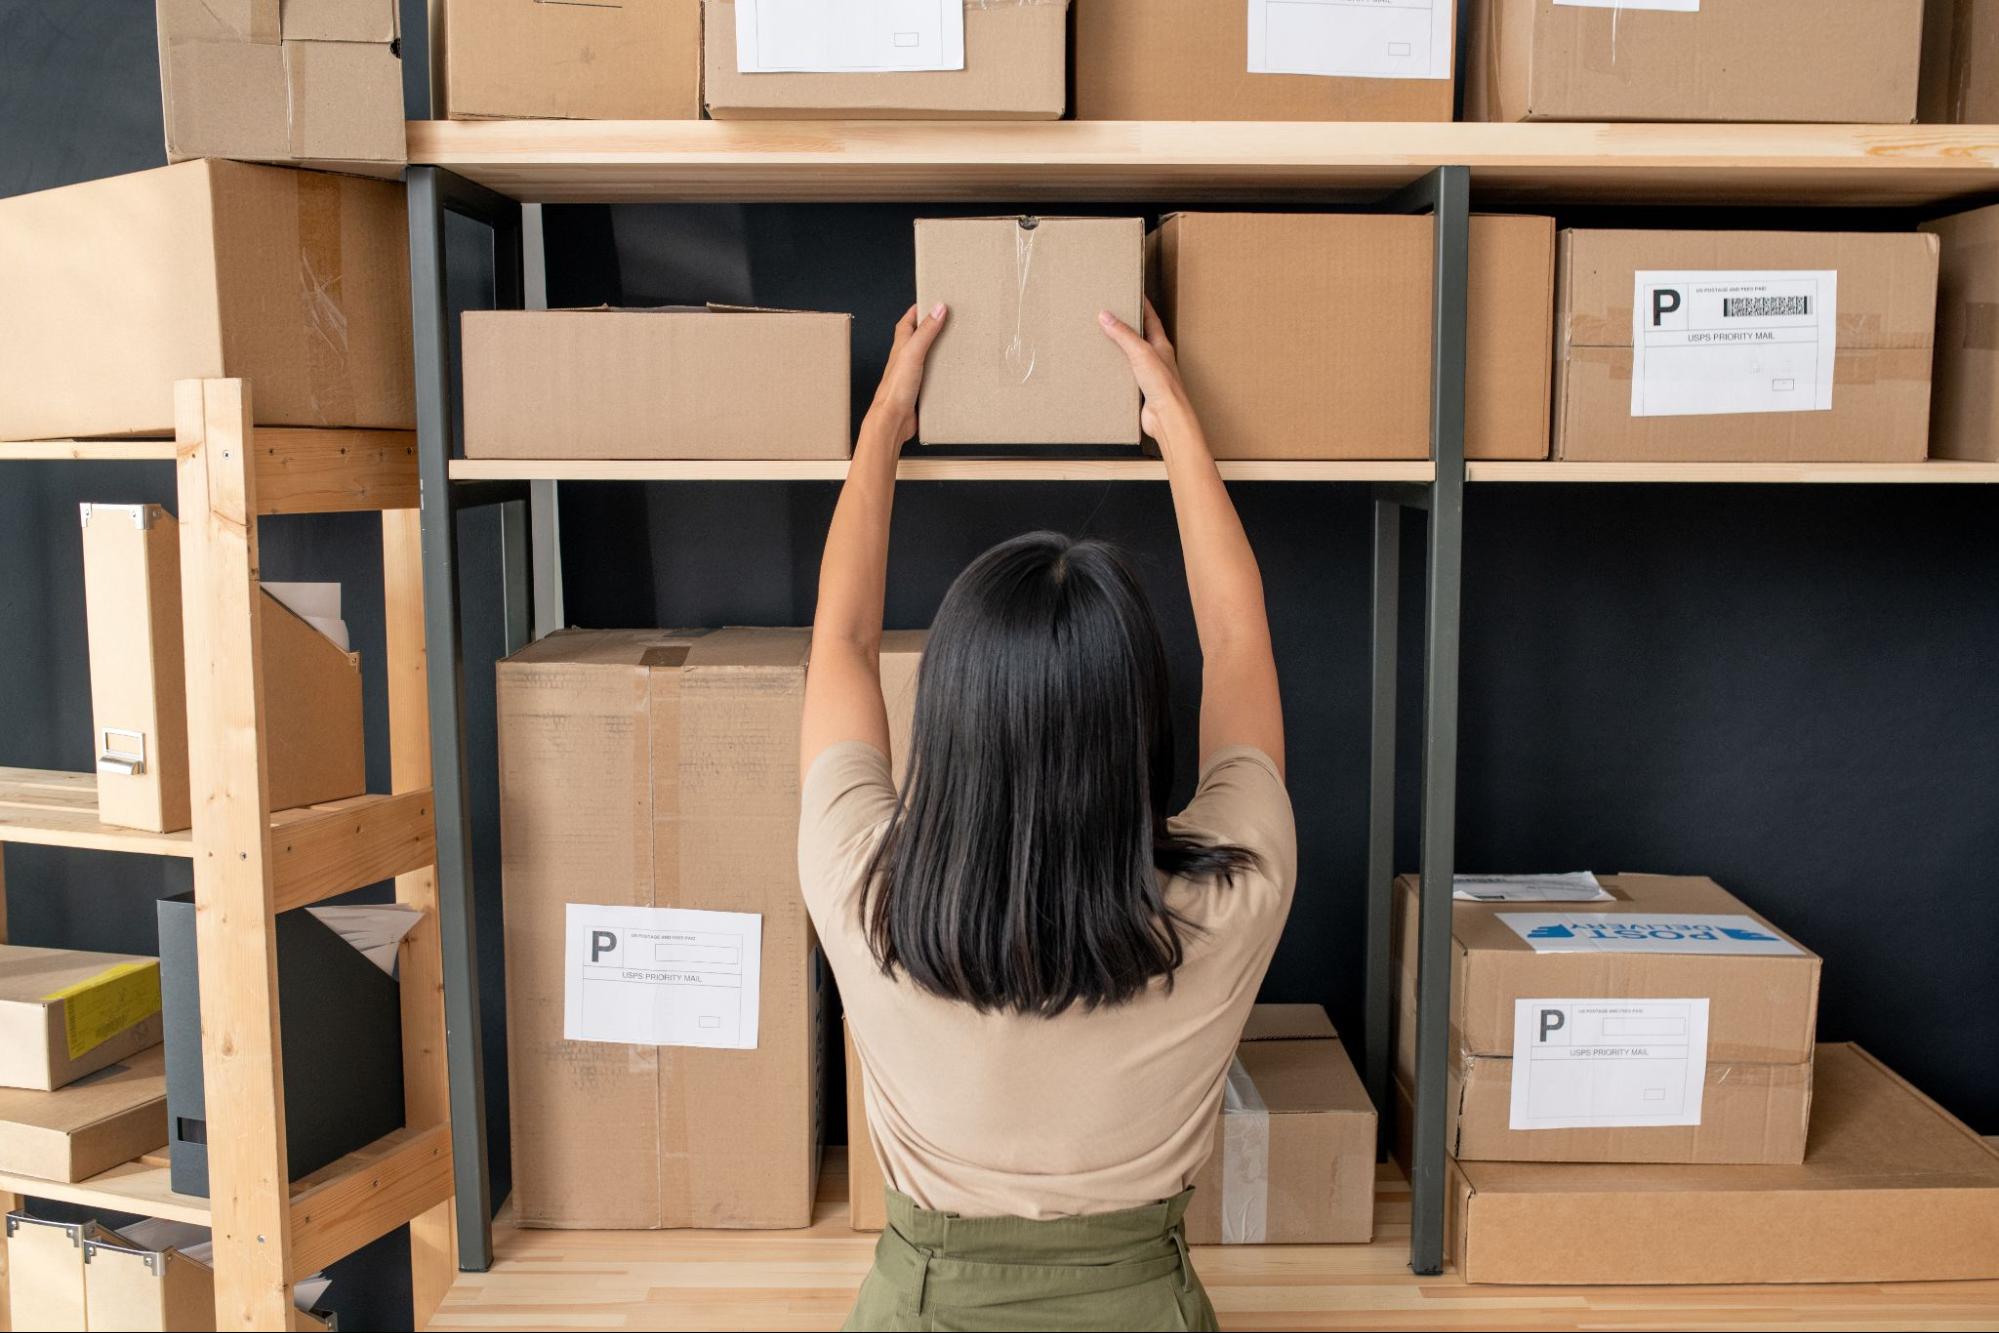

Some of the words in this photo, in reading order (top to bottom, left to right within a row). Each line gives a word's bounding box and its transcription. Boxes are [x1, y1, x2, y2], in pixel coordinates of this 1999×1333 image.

[1653, 289, 1681, 326] P
[1688, 334, 1711, 342] USPS
[1713, 333, 1752, 341] PRIORITY
[1755, 332, 1775, 340] MAIL
[1588, 929, 1719, 940] POST
[591, 931, 617, 962] P
[645, 973, 682, 981] PRIORITY
[1540, 1009, 1565, 1042] P
[1570, 1048, 1591, 1056] USPS
[1593, 1048, 1629, 1056] PRIORITY
[1631, 1048, 1649, 1056] MAIL
